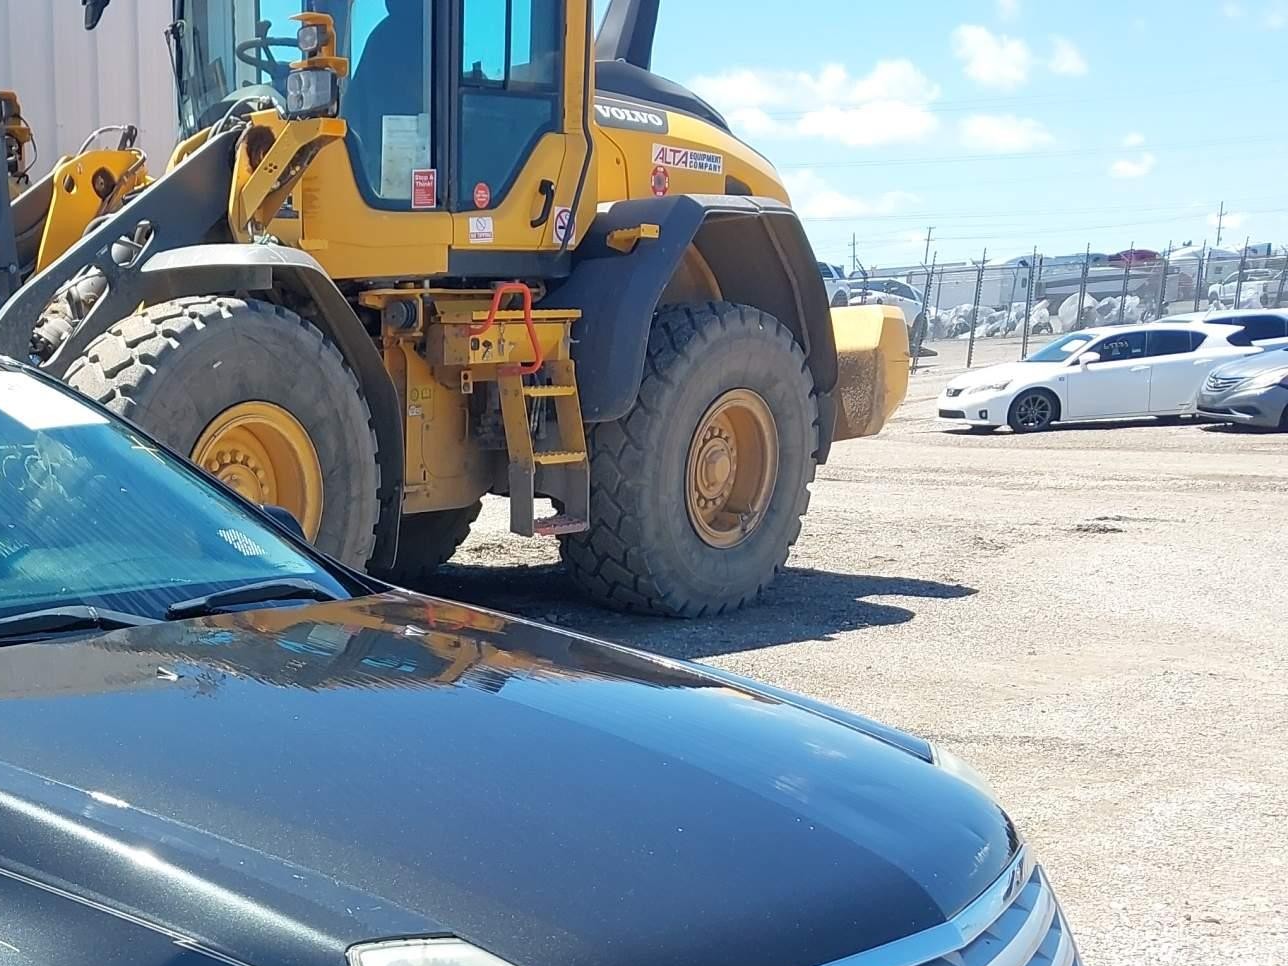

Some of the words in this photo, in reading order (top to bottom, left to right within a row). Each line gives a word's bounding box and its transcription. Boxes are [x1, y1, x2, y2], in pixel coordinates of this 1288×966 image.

[594, 105, 663, 126] VOLVO
[654, 147, 689, 168] ALTA
[689, 153, 721, 165] EQUIPMENT
[689, 161, 721, 172] COMPANY
